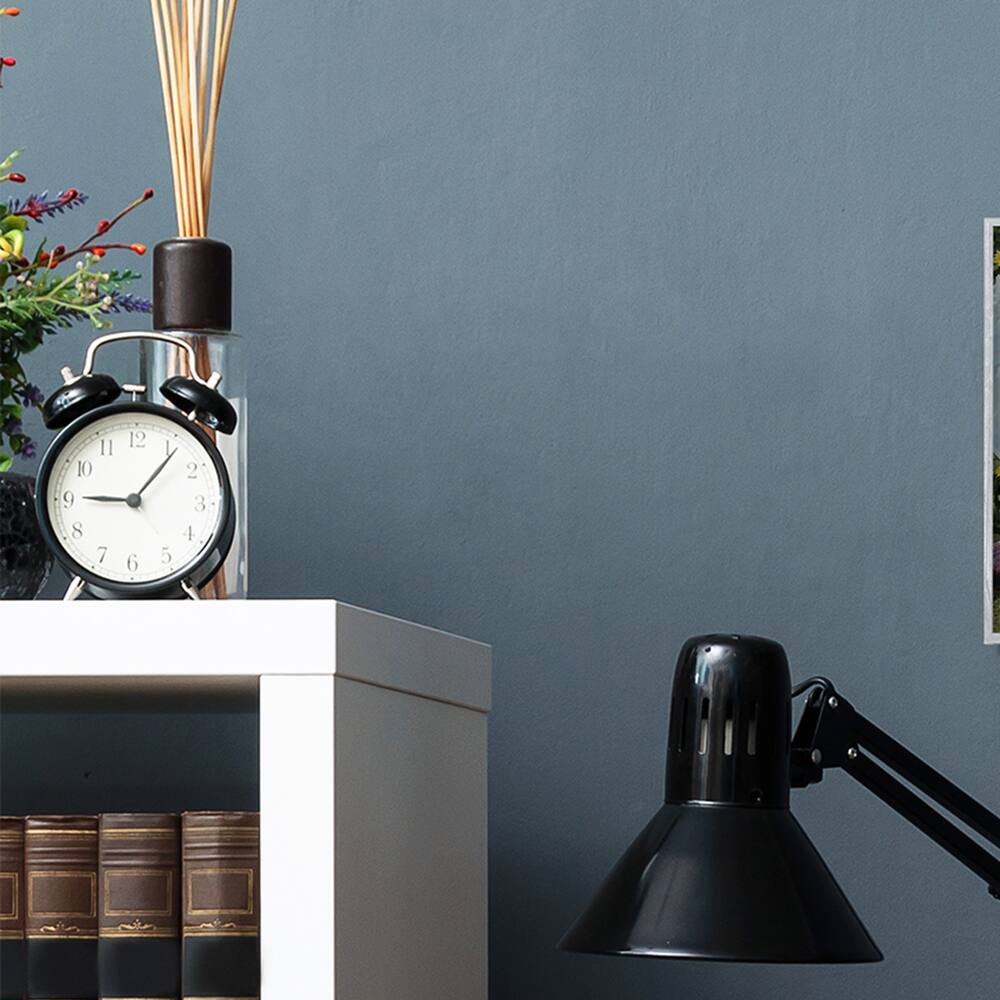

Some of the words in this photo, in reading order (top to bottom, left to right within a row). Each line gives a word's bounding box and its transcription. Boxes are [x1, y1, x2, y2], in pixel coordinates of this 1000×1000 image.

[100, 439, 113, 456] 11
[129, 431, 146, 448] 12
[165, 439, 171, 456] 1
[77, 460, 92, 477] 10
[186, 462, 198, 479] 2
[63, 490, 74, 509] 9
[194, 495, 206, 512] 3
[71, 521, 83, 539] 8
[182, 525, 195, 541] 4
[97, 546, 108, 563] 7
[127, 554, 138, 572] 6
[161, 547, 172, 564] 5
